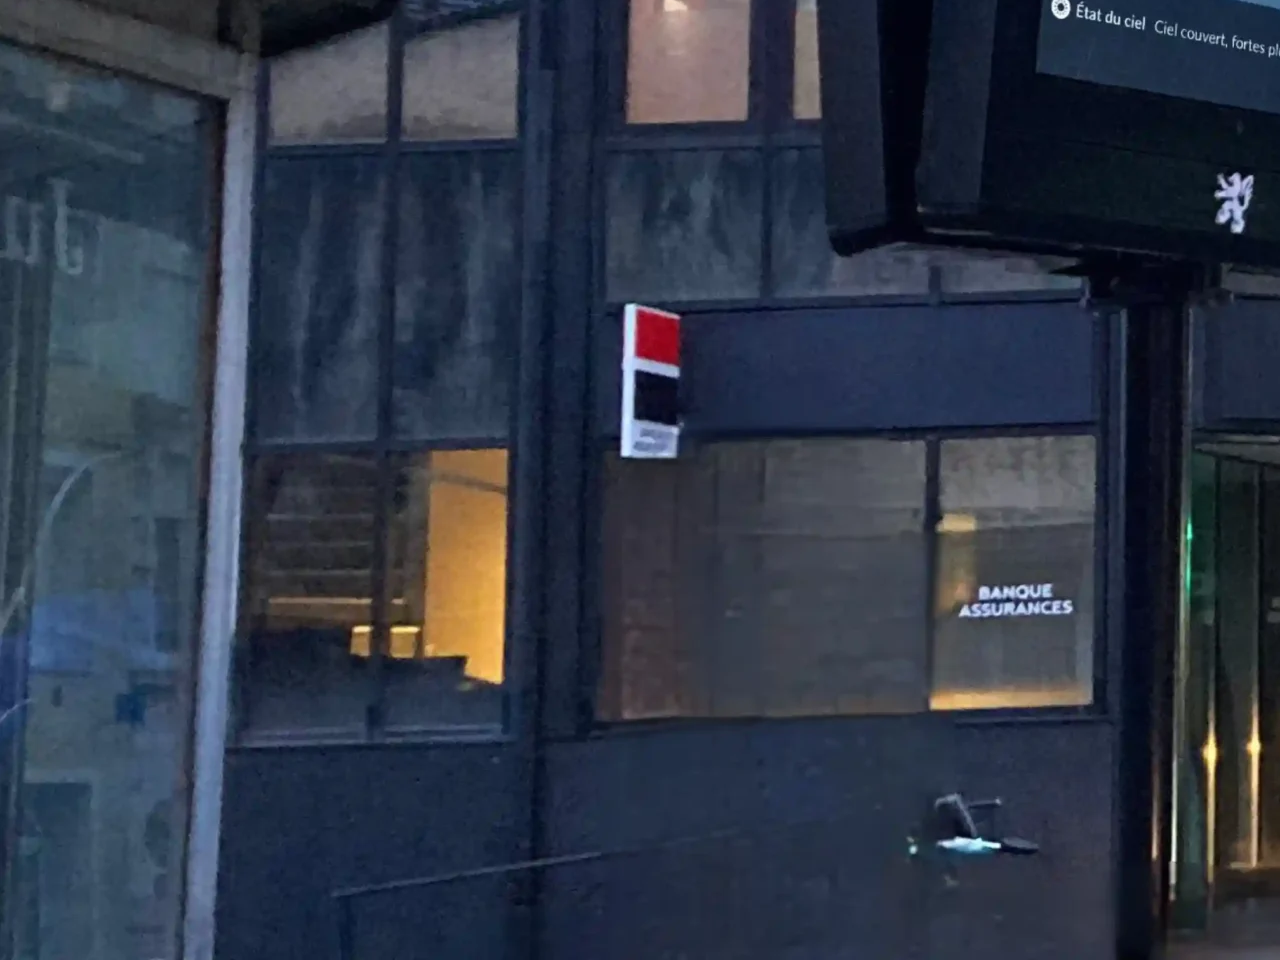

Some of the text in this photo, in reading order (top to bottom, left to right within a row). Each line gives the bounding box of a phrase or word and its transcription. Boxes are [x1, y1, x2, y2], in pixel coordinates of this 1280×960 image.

[1075, 1, 1102, 22] État
[1105, 10, 1121, 26] du
[1124, 15, 1146, 31] ciel
[1154, 20, 1178, 37] Ciel
[1180, 28, 1228, 48] couvert,
[1231, 35, 1266, 55] fortes
[977, 582, 1054, 602] BANQUE
[958, 599, 1074, 619] ASSURANCES
